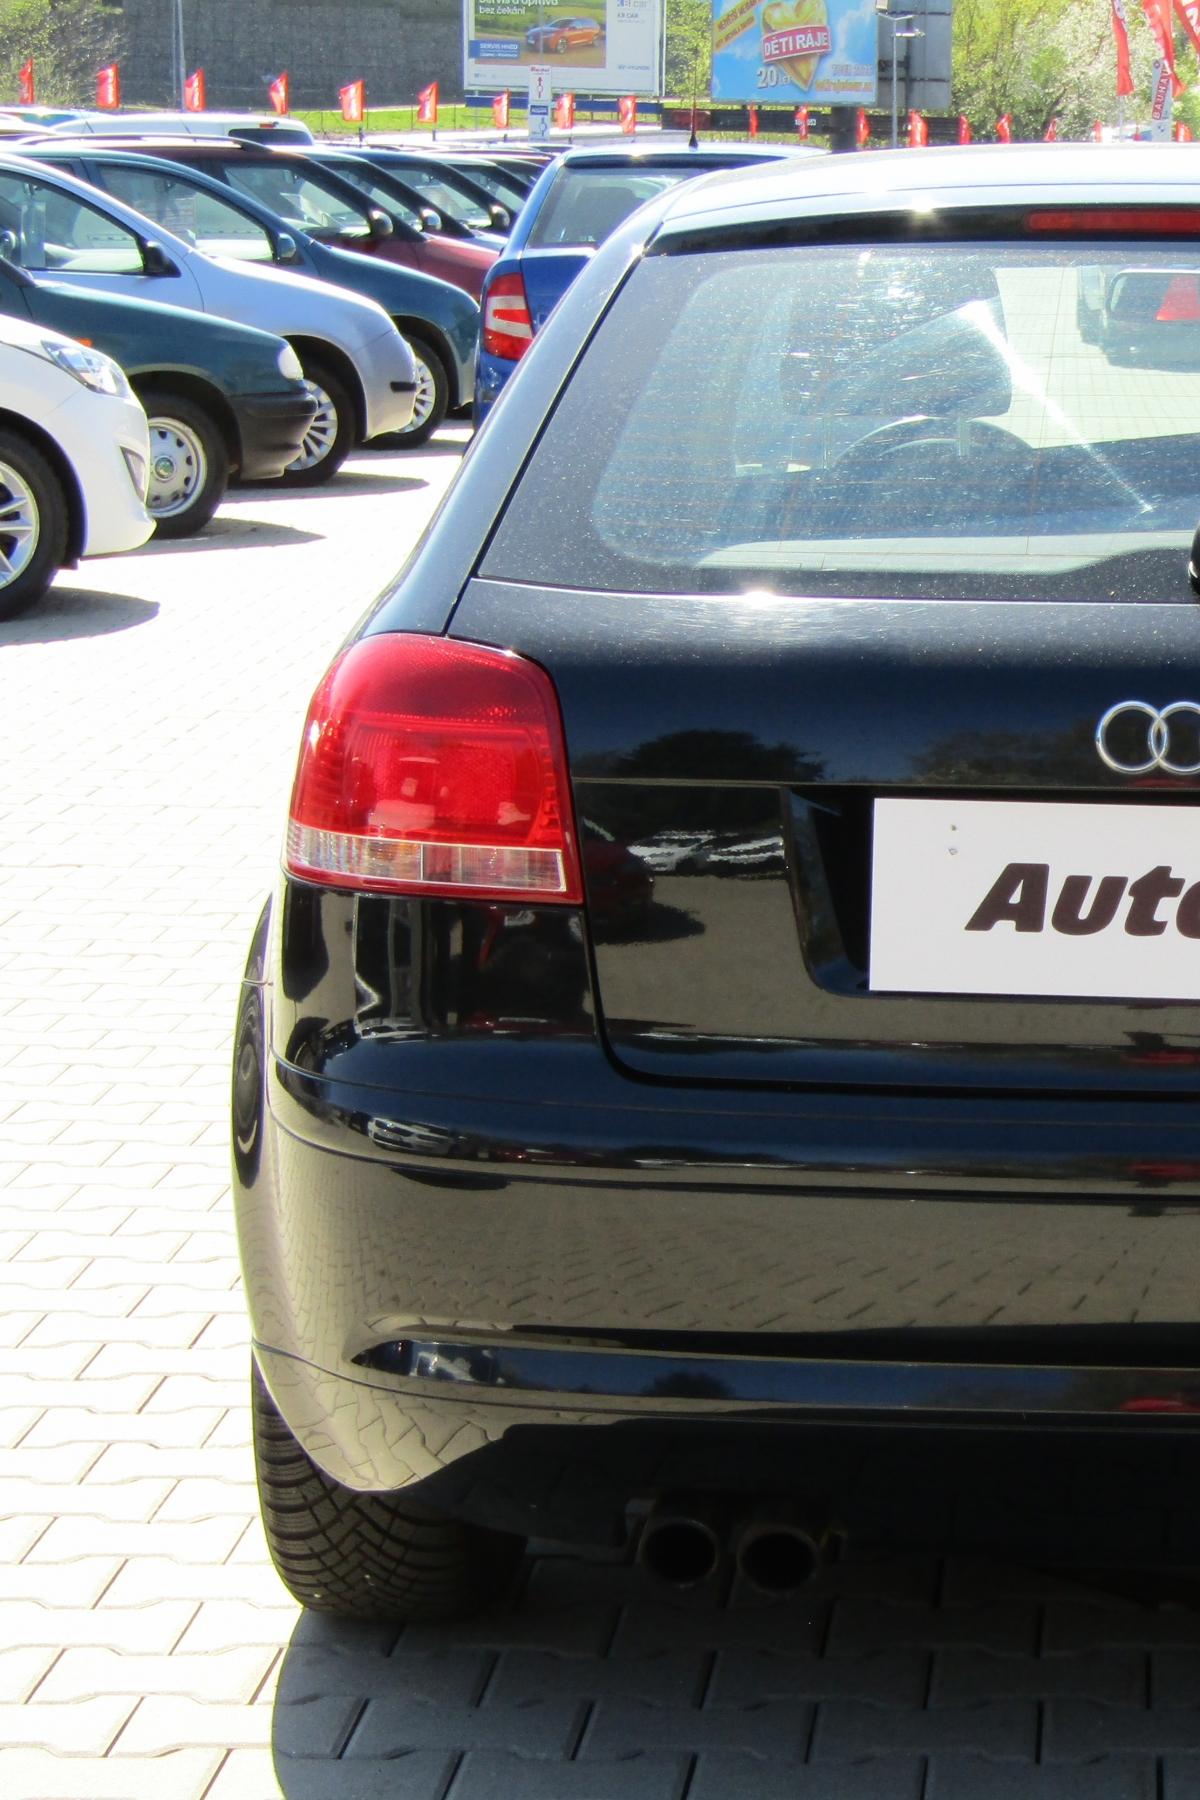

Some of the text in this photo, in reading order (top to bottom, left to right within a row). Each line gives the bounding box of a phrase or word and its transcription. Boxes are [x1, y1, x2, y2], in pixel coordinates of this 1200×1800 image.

[479, 6, 495, 15] bez
[796, 29, 829, 50] RÁJE
[757, 66, 777, 88] 20
